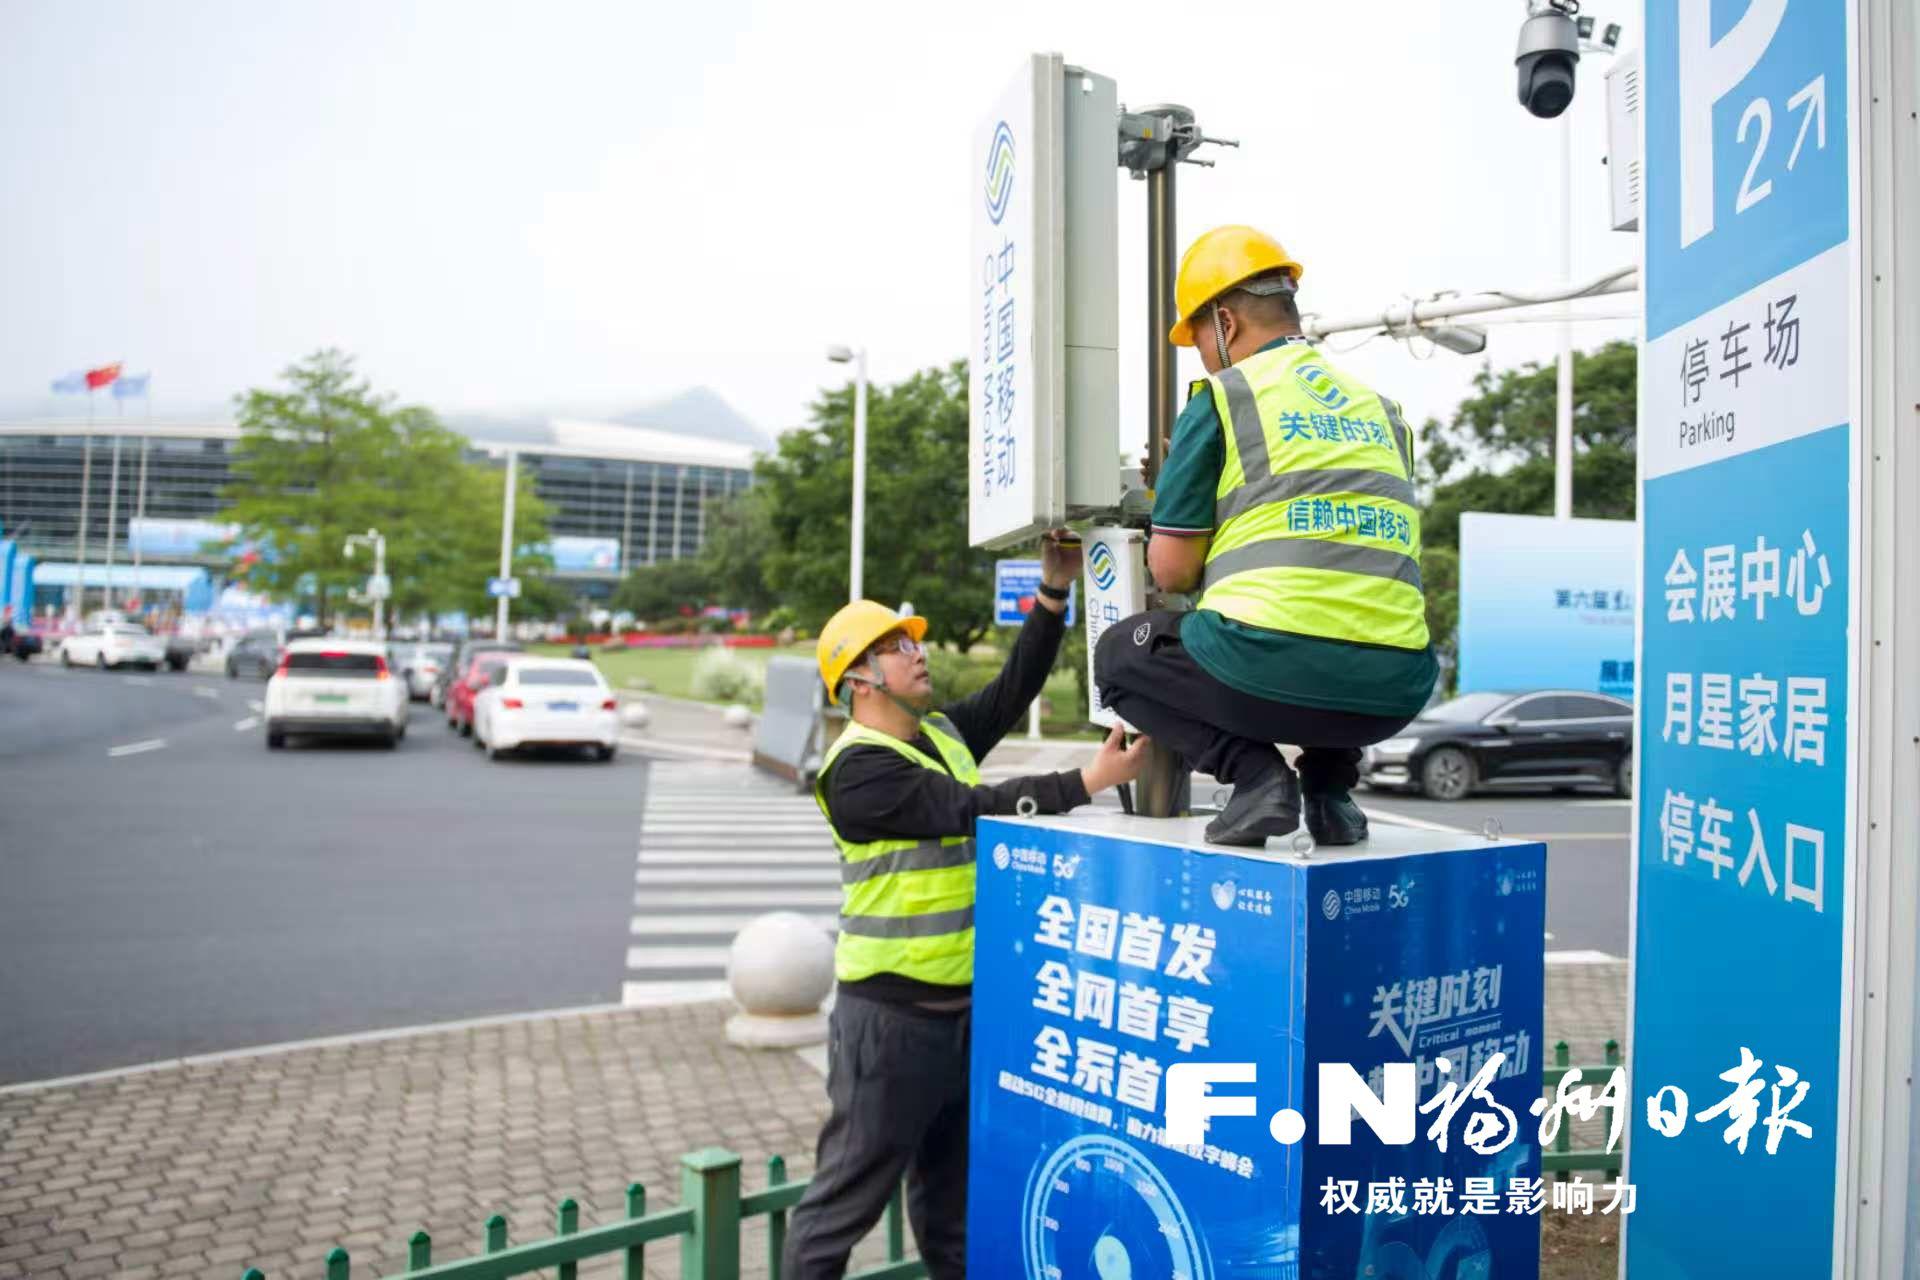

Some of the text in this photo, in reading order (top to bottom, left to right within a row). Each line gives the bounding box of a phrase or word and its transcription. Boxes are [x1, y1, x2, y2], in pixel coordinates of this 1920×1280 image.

[1735, 97, 1772, 215] 2
[983, 253, 994, 497] China Mobile
[997, 235, 1016, 488] 中国移动
[1680, 294, 1800, 408] 停车场
[1279, 411, 1393, 450] 关键时刻
[1680, 408, 1735, 448] Parking
[1286, 498, 1410, 545] 信赖中国移动
[1664, 528, 1831, 624] 会展中心
[1662, 672, 1829, 766] 月星家居
[1659, 788, 1825, 914] 停车入口
[1033, 894, 1217, 986] 全国首发
[1032, 960, 1213, 1053] 全网首享
[1368, 964, 1502, 1058] 关键时刻
[1418, 1027, 1459, 1049] Critical
[1030, 1024, 1212, 1132] 全系首
